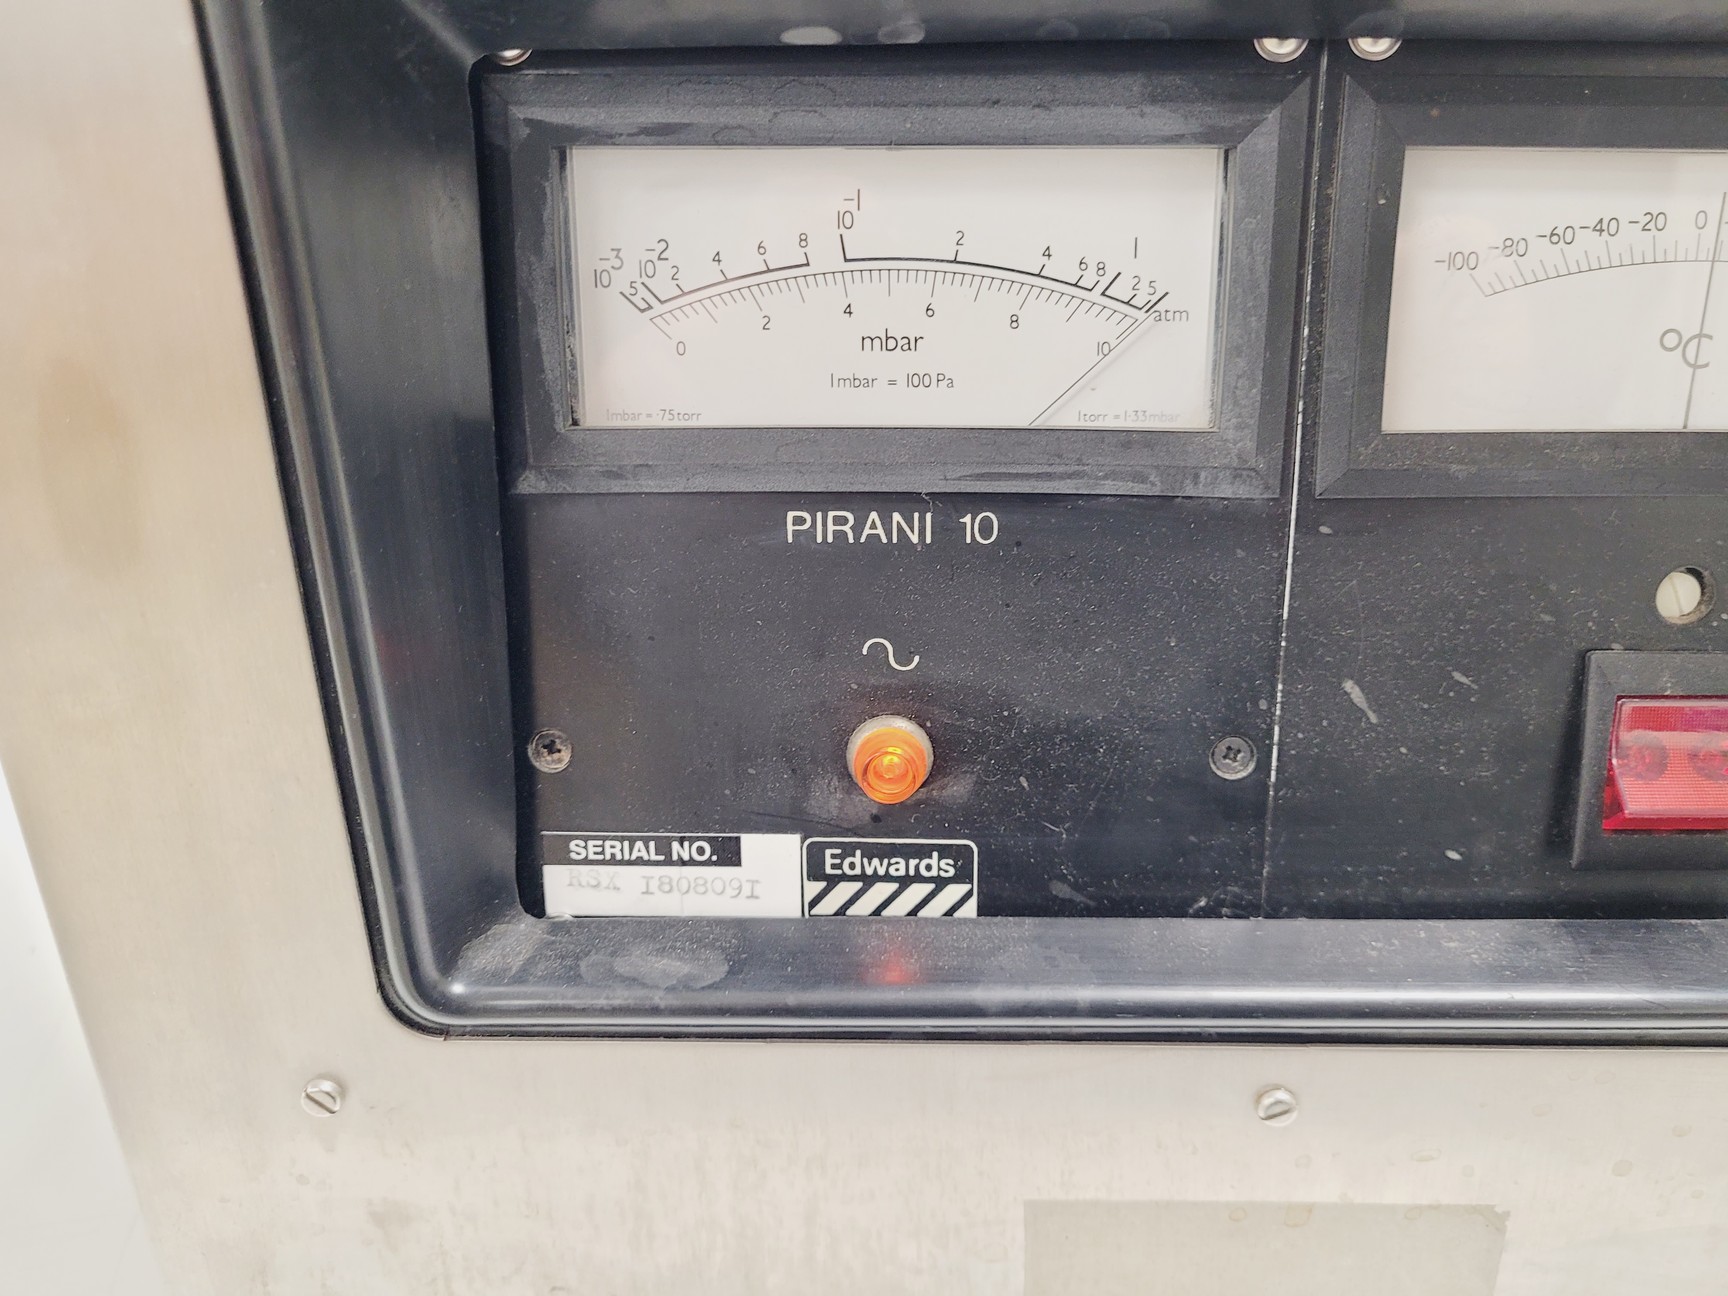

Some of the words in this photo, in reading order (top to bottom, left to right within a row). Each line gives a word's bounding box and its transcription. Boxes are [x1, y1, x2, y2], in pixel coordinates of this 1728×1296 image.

[1535, 225, 1576, 245] -60
[1579, 217, 1620, 237] -40
[1628, 211, 1668, 232] -20
[1694, 209, 1708, 230] 0
[629, 281, 638, 296] 5
[671, 265, 680, 281] 2
[712, 250, 722, 266] 4
[757, 240, 767, 256] 6
[798, 232, 808, 248] 8
[955, 230, 965, 246] 2
[1042, 245, 1052, 261] 4
[1078, 256, 1088, 272] 6
[1096, 261, 1106, 277] 8
[1131, 275, 1141, 291] 2
[1147, 280, 1157, 296] 5
[1153, 308, 1189, 322] atm
[675, 340, 686, 356] 0
[761, 315, 771, 331] 2
[843, 302, 853, 318] 4
[925, 302, 935, 318] 6
[1009, 314, 1020, 330] 8
[1096, 340, 1112, 357] 10
[861, 327, 924, 352] mbar
[786, 510, 933, 544] PIRANI
[958, 511, 999, 545] 10
[568, 838, 666, 862] SERIAL
[671, 841, 718, 863] NO.
[824, 848, 956, 879] Edwards
